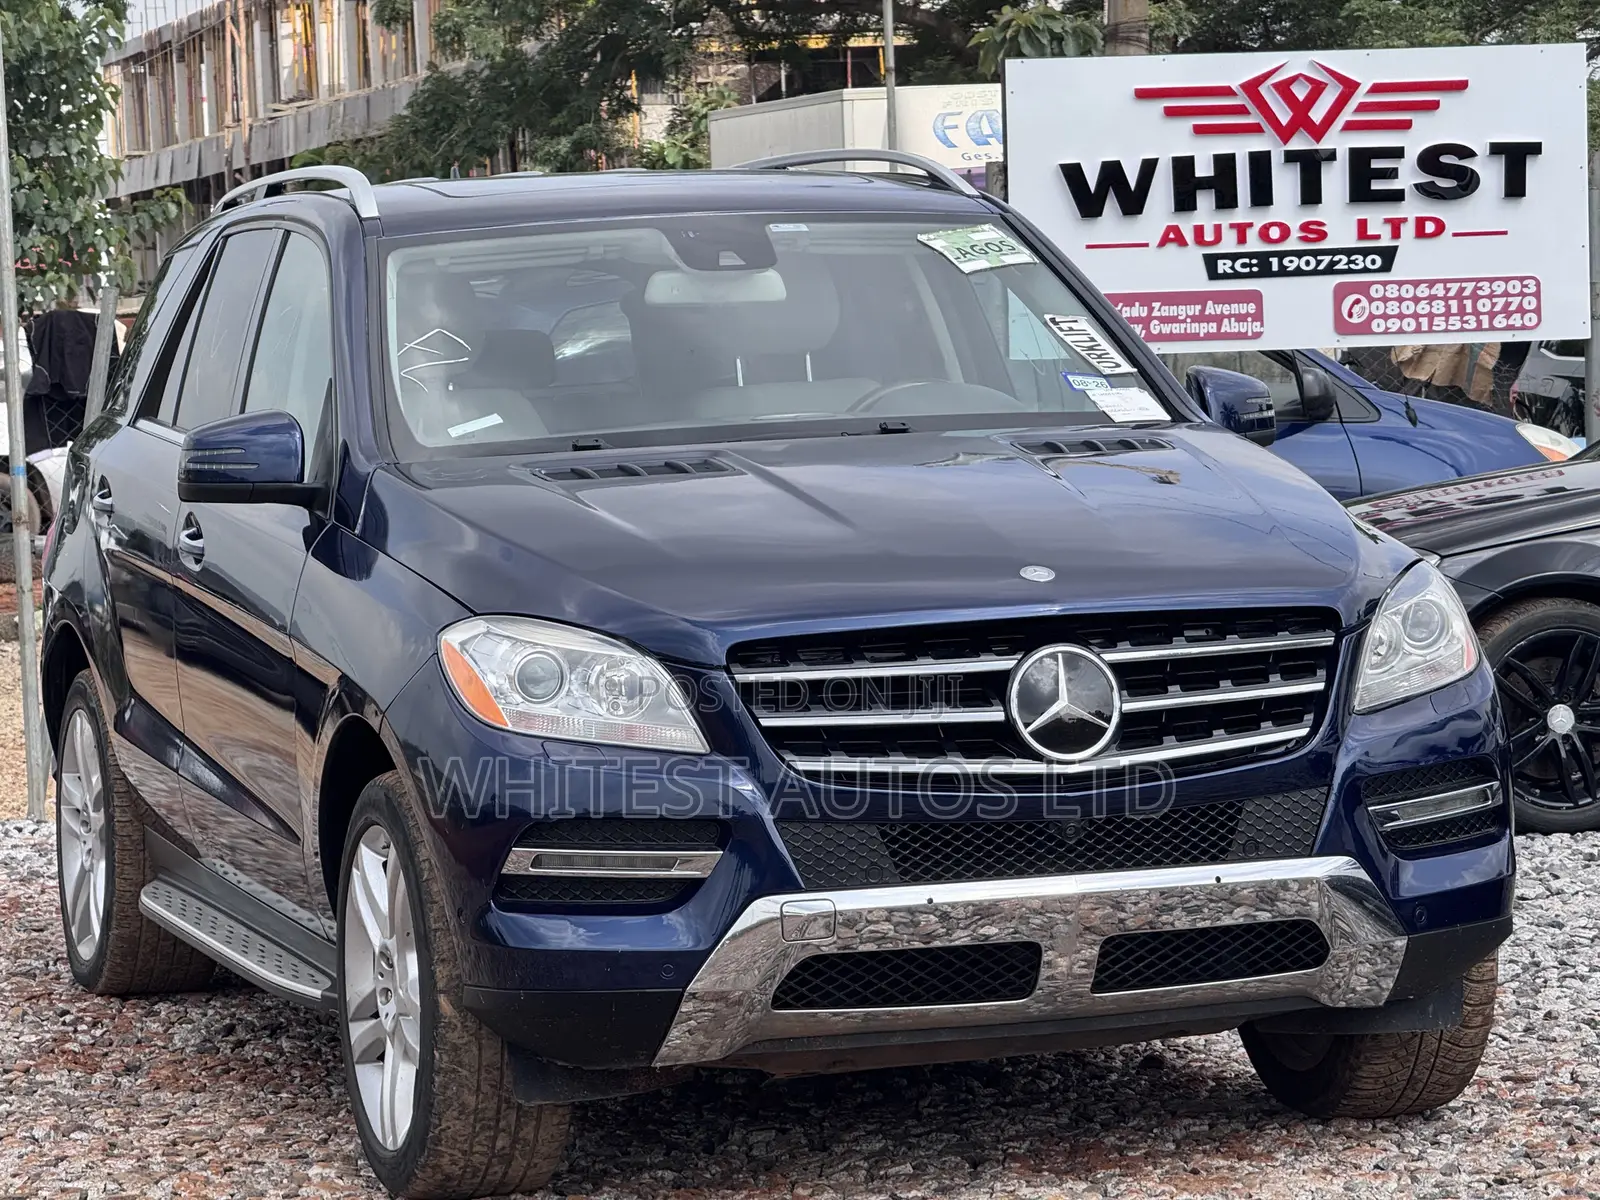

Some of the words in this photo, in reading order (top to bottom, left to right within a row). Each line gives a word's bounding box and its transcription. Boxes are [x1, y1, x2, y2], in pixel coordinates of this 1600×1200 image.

[961, 152, 1003, 161] Ges.
[1057, 141, 1543, 219] WHITEST
[1156, 220, 1329, 248] AUTOS
[1355, 216, 1447, 241] LTD
[1217, 258, 1260, 274] RC:
[1268, 254, 1383, 272] 1907230
[1369, 279, 1537, 298] 08064773903
[1151, 301, 1202, 320] Zangur
[1205, 300, 1257, 316] Avenue
[1370, 296, 1538, 315] 08068110770
[1150, 318, 1218, 338] Gwarinpa
[1220, 317, 1264, 337] Abuja.
[1371, 312, 1538, 332] 09015531640
[1049, 317, 1122, 371] ORKLIFT
